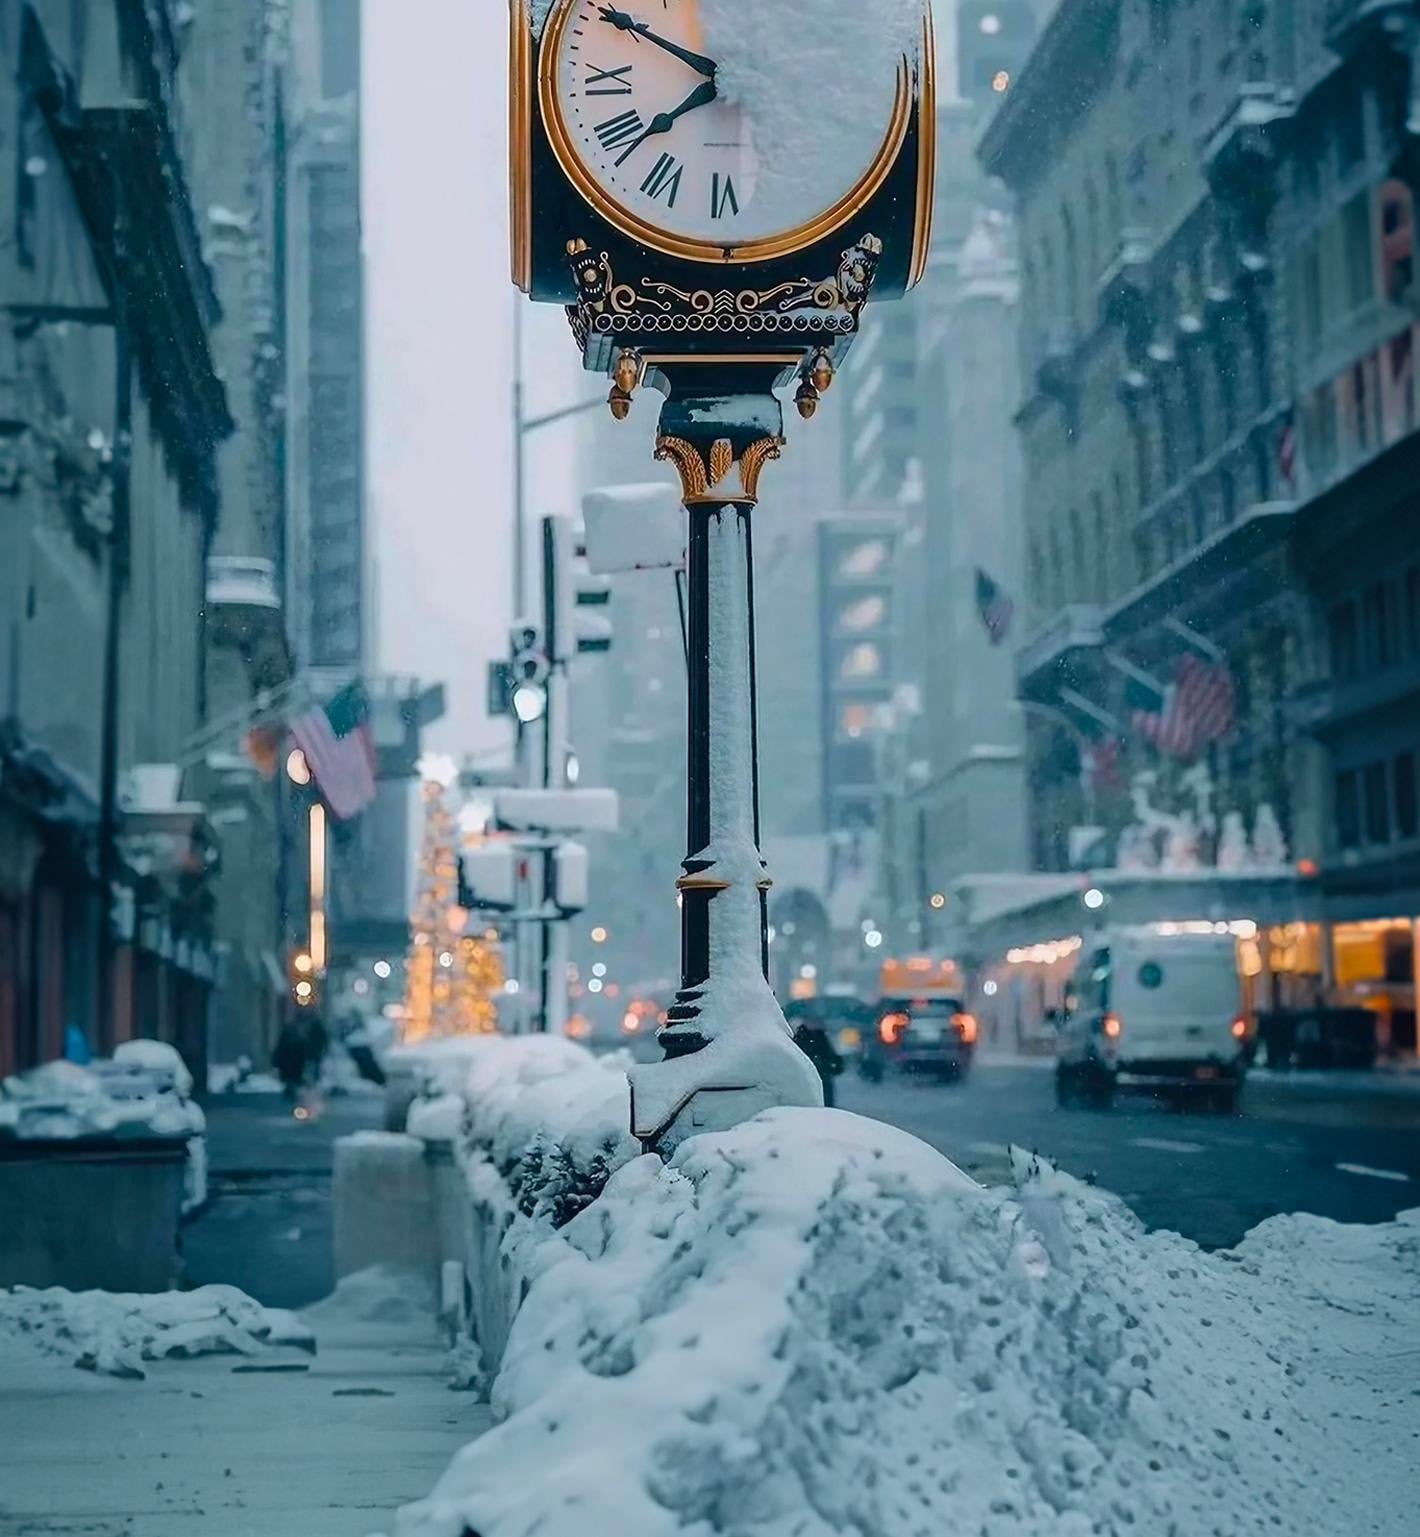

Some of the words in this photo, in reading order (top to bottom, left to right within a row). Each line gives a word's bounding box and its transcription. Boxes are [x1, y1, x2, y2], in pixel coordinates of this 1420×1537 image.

[585, 63, 632, 96] IX
[593, 109, 644, 168] VIII
[639, 152, 683, 208] VII
[711, 172, 739, 219] VI
